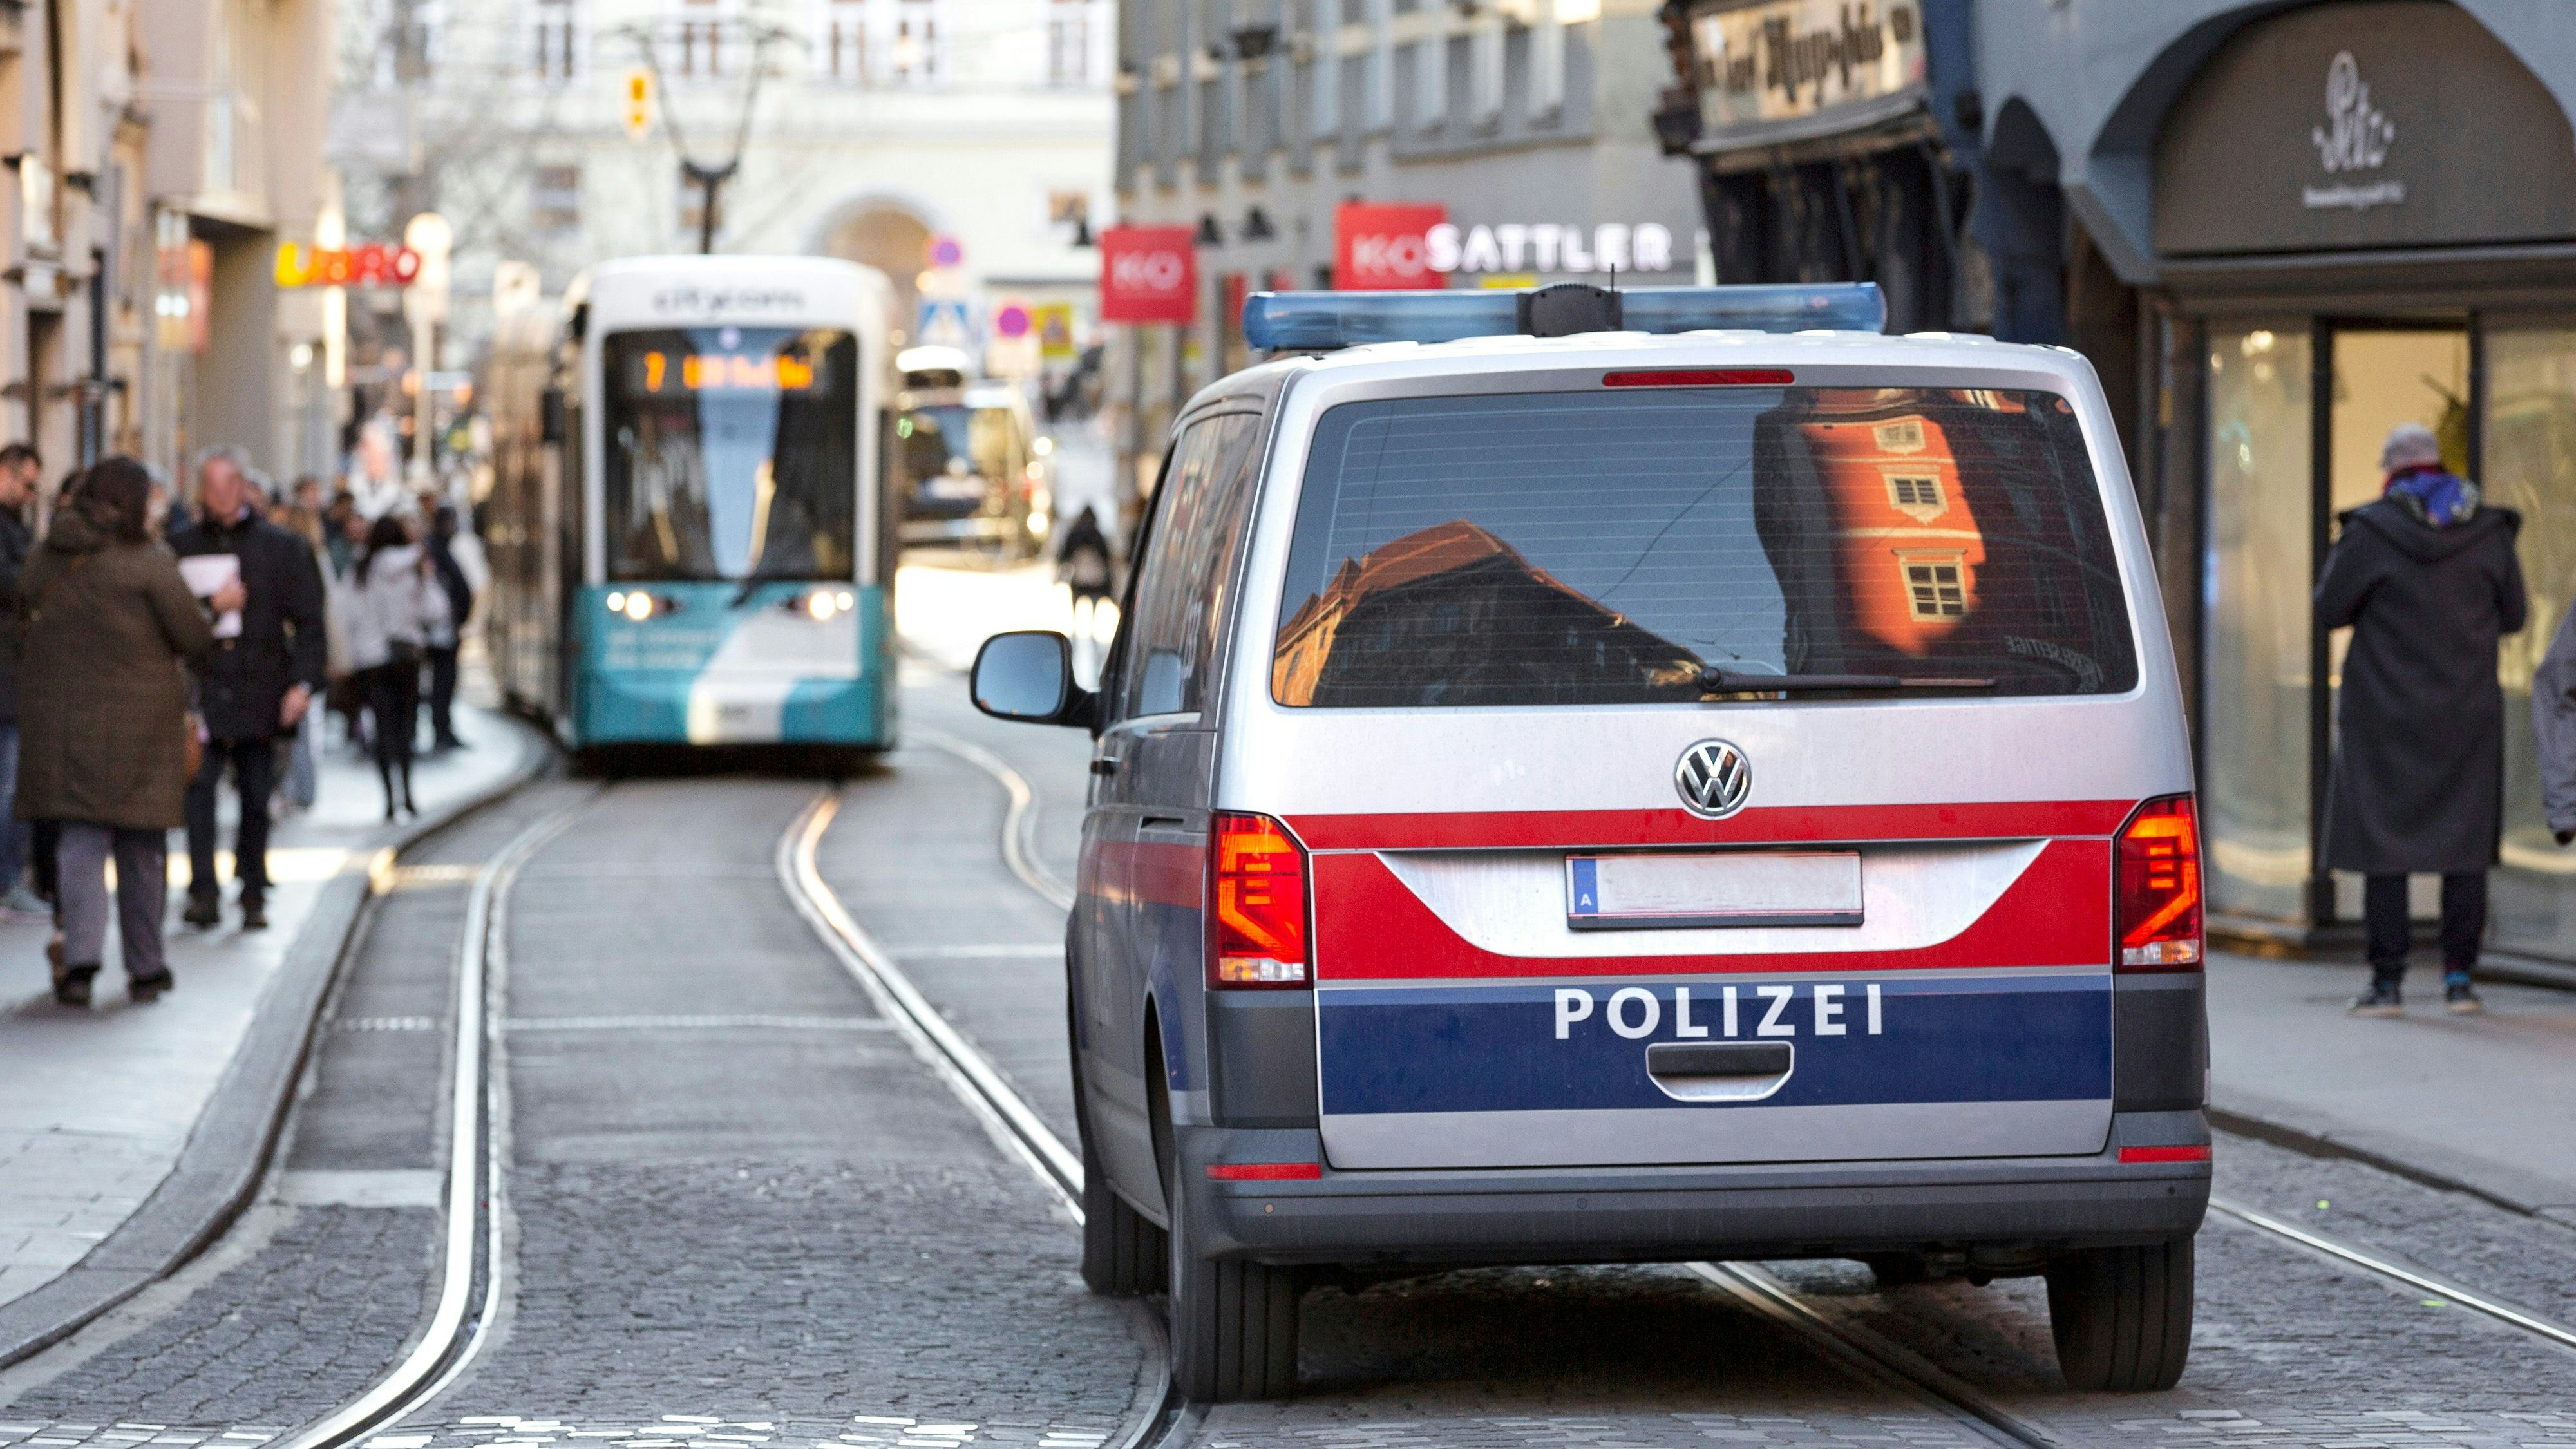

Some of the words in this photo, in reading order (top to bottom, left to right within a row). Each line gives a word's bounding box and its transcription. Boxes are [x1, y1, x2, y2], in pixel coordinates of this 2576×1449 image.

[1425, 223, 1672, 273] SATTLER
[1580, 893, 1592, 906] A
[1555, 984, 1882, 1039] POLIZEI
